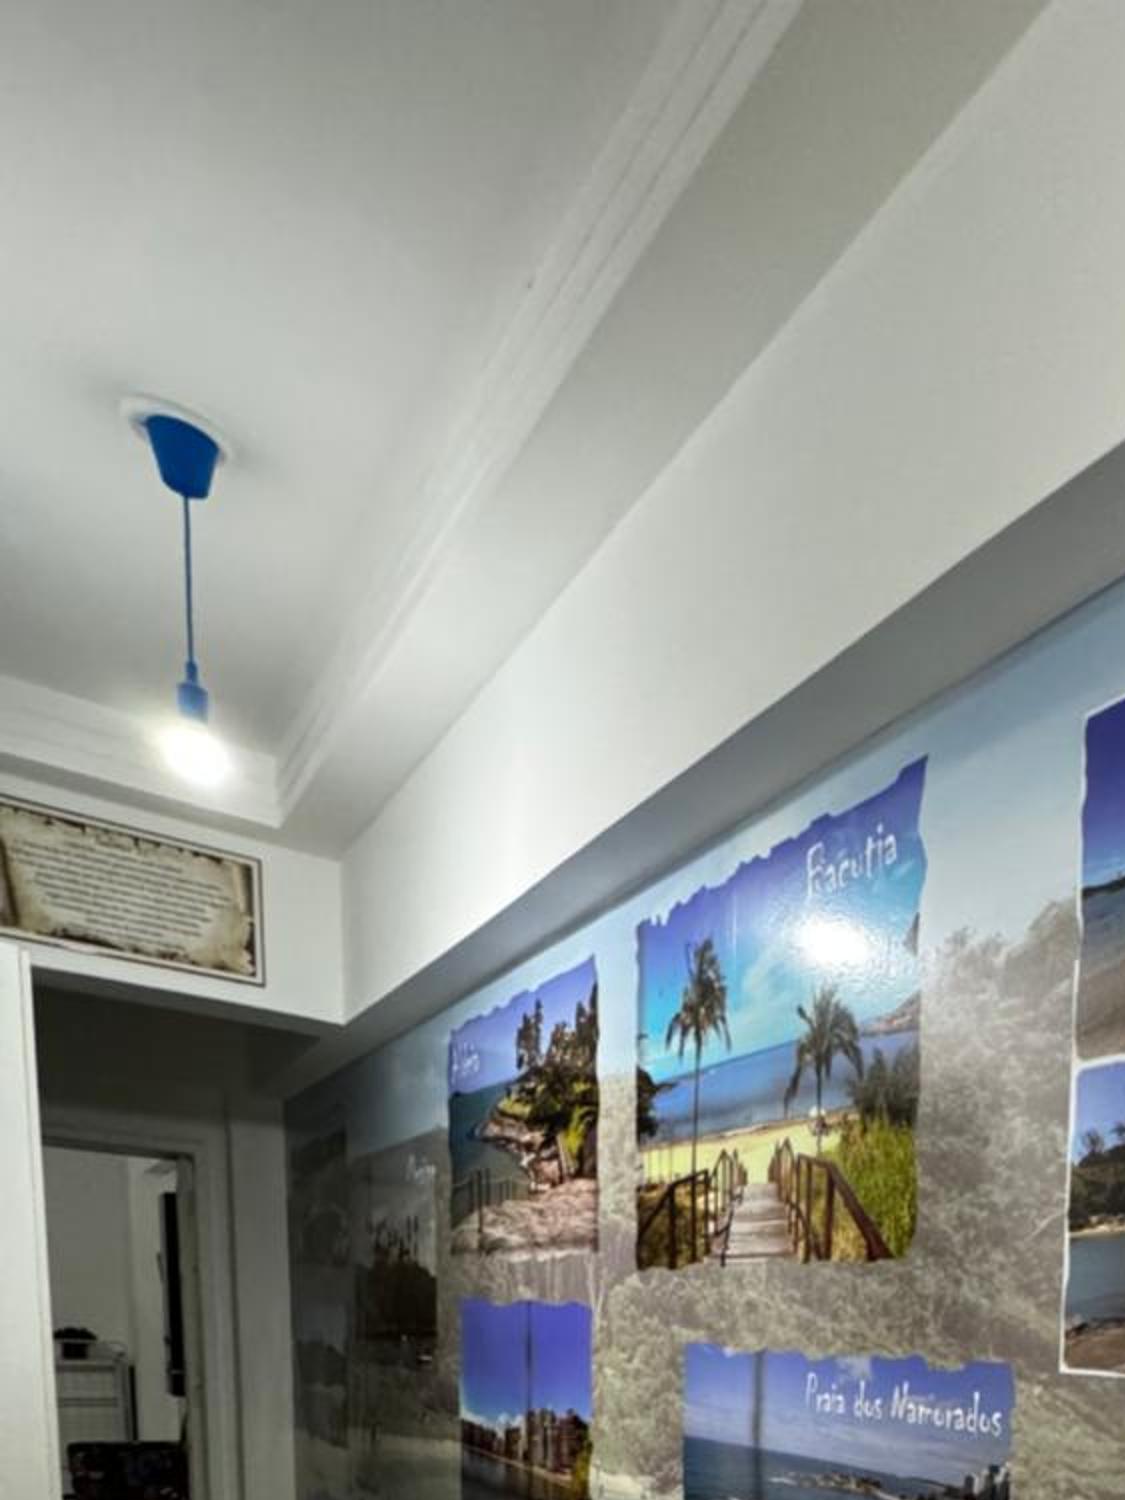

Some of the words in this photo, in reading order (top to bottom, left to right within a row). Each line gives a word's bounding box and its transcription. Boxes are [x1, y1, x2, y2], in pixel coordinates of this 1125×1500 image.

[805, 1371, 846, 1414] Praia
[853, 1379, 883, 1420] dos
[889, 1380, 1004, 1437] Namorados
